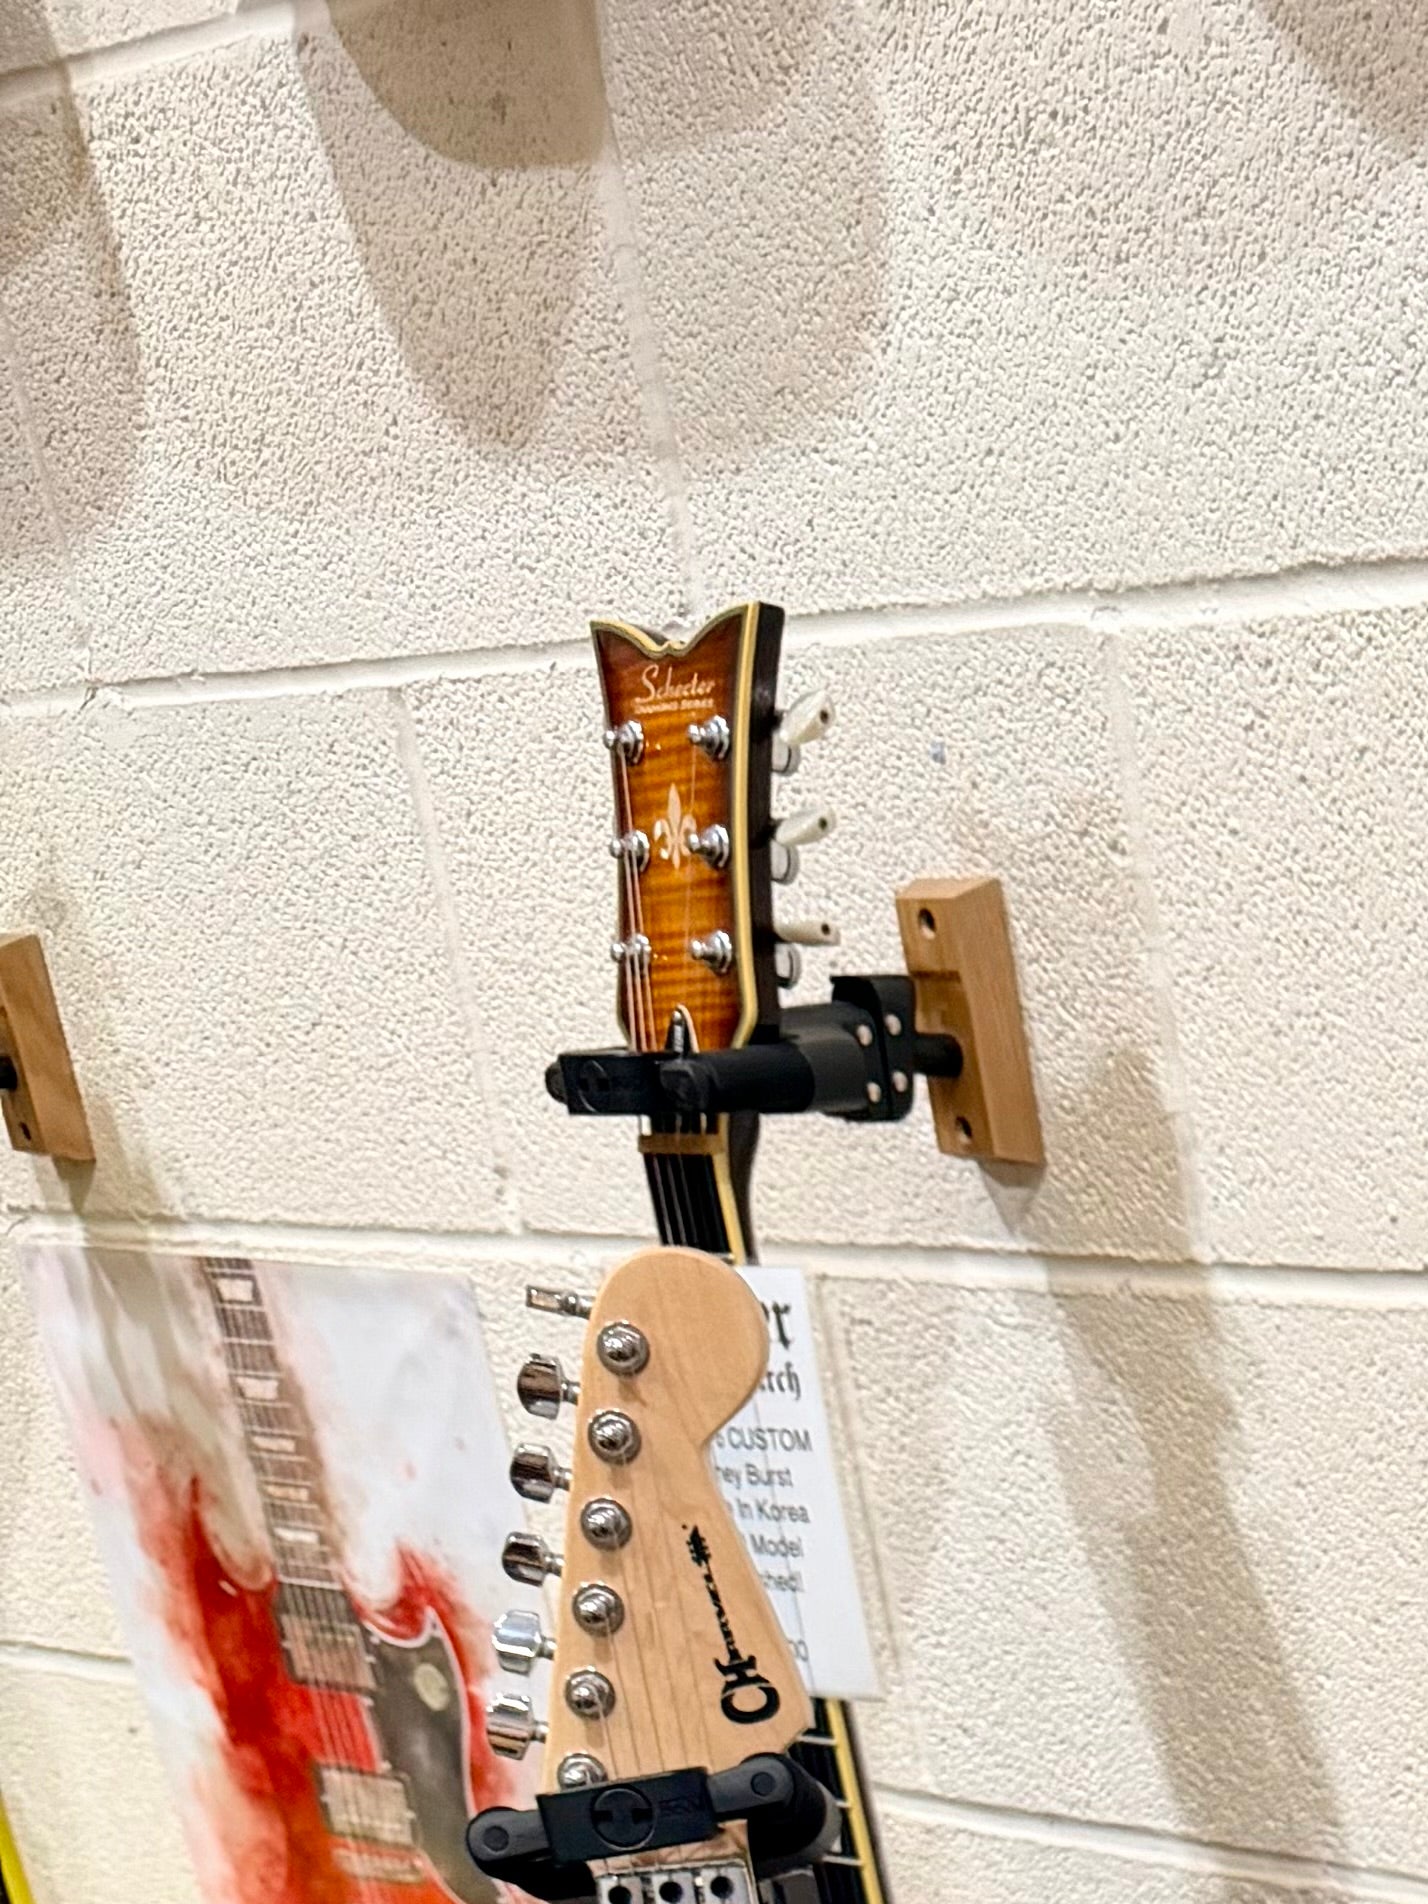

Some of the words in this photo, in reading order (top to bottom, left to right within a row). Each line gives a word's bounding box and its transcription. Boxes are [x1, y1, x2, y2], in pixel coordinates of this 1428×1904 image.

[634, 663, 716, 702] Schecter
[727, 1427, 813, 1452] CUSTOM
[745, 1463, 793, 1487] Burst
[756, 1500, 811, 1524] Korea
